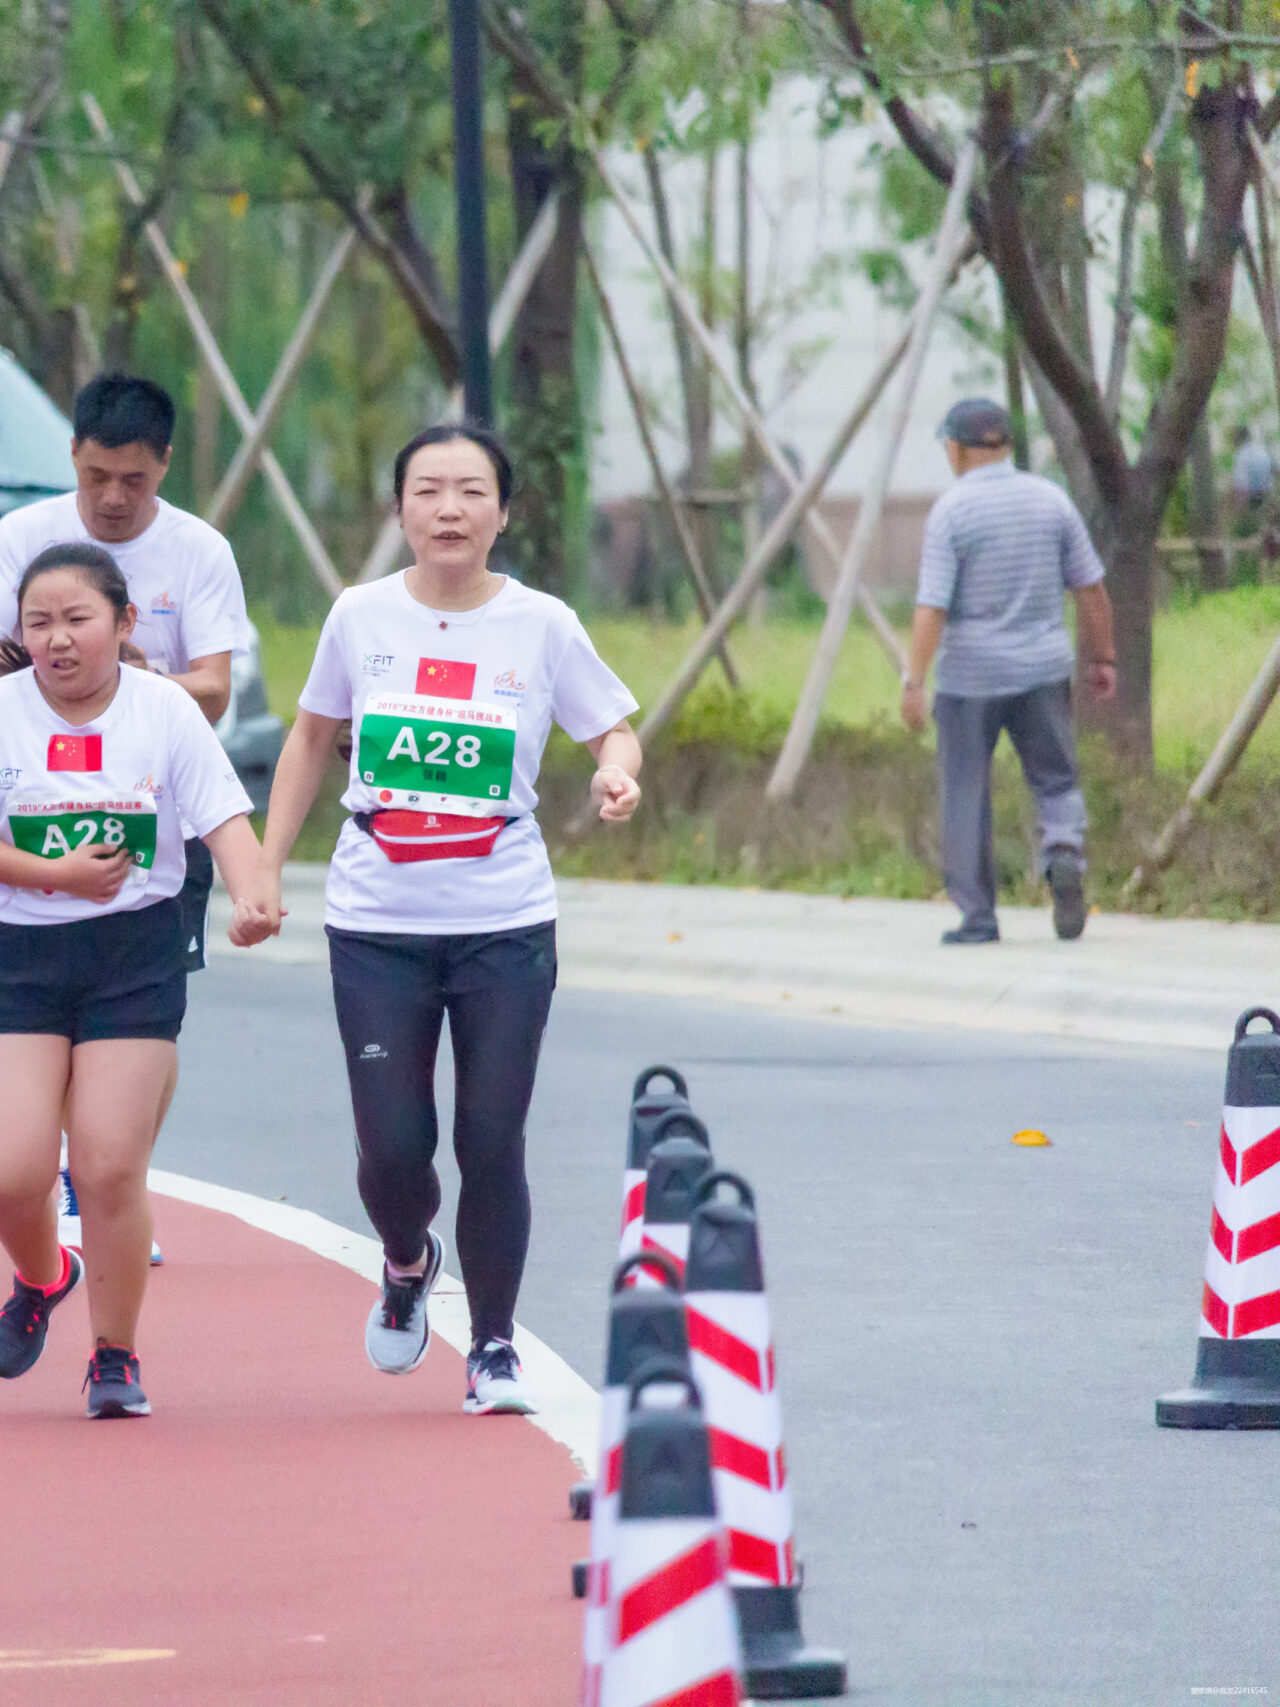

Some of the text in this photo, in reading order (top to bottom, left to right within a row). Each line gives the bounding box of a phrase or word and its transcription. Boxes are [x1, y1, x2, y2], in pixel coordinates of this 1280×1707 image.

[363, 654, 395, 666] XFIT
[386, 726, 482, 768] A28
[41, 817, 126, 856] A28
